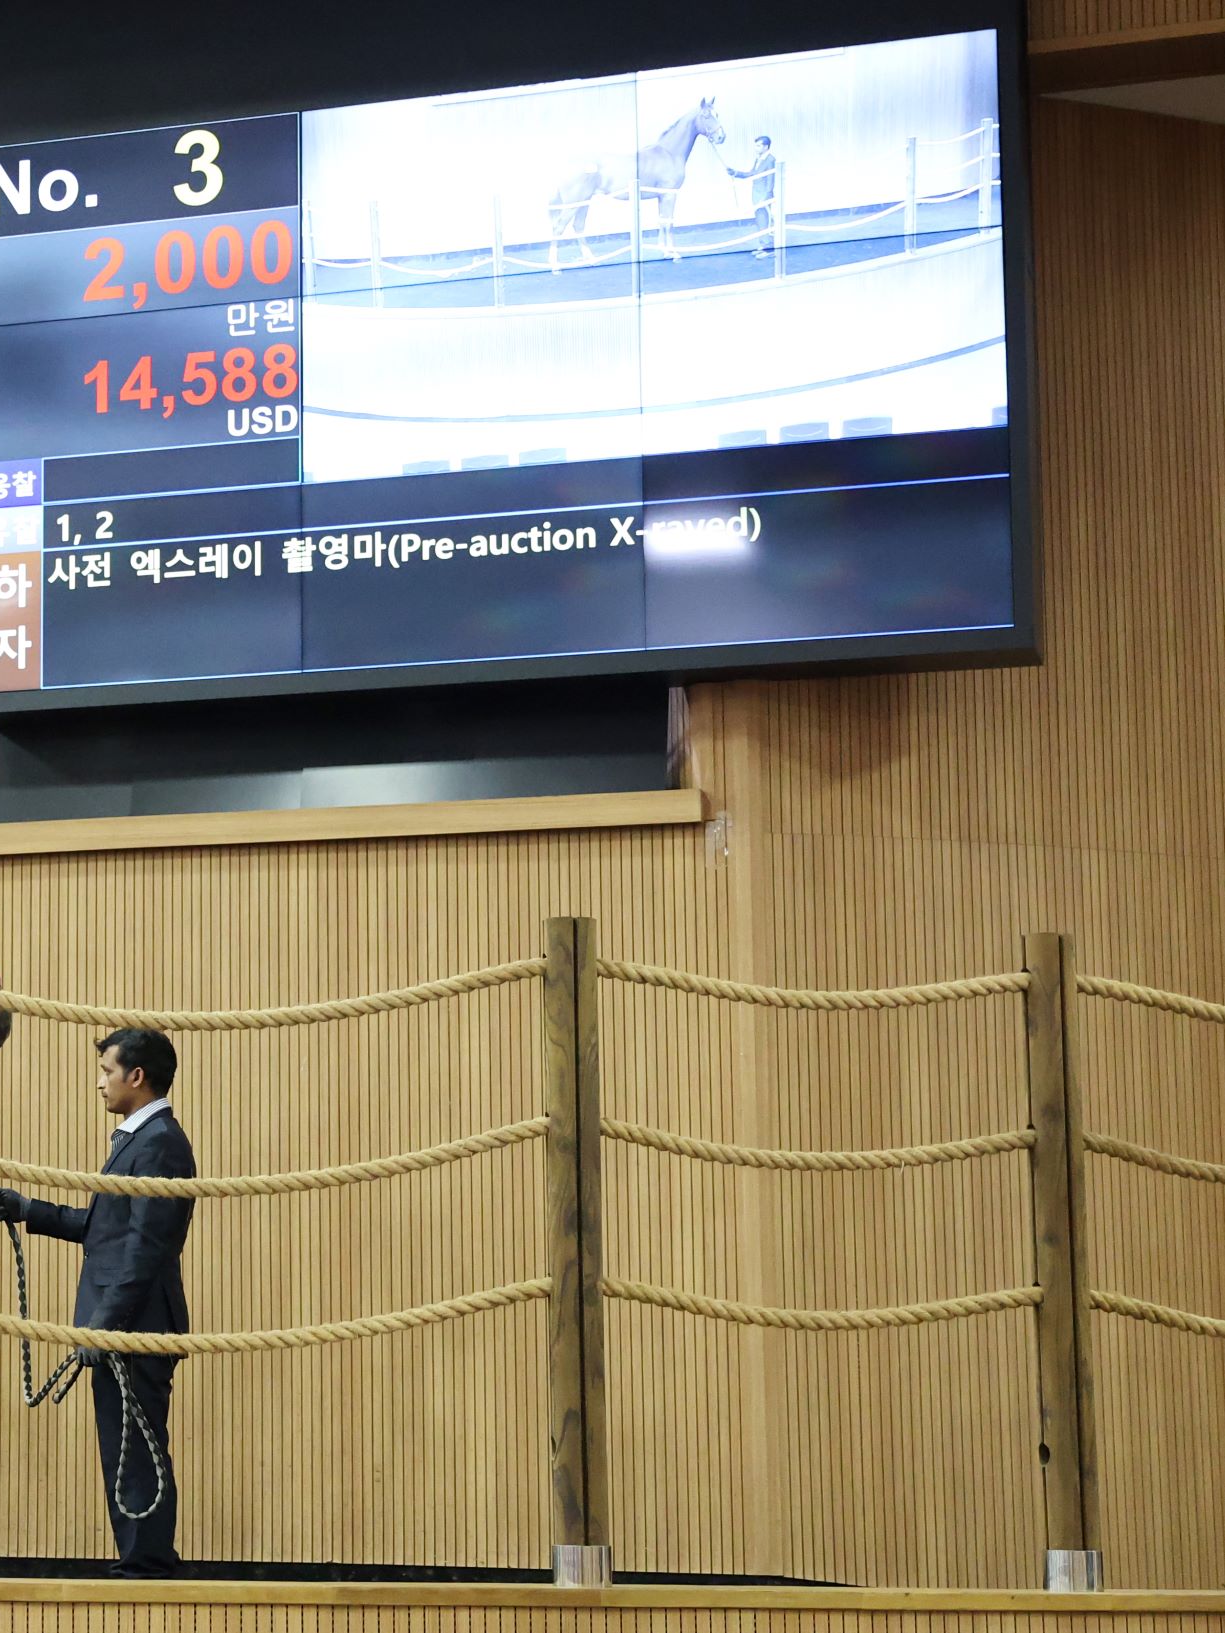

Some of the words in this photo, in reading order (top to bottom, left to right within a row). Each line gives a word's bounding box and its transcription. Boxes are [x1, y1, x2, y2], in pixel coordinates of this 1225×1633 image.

[173, 129, 224, 206] 3
[83, 220, 293, 310] 2,000
[227, 299, 295, 336] 만원
[83, 343, 299, 419] 14,588
[227, 404, 298, 436] USD
[56, 513, 82, 546] 1,
[95, 511, 114, 540] 2
[47, 551, 112, 590] 사전
[129, 541, 263, 584] 엑스레이
